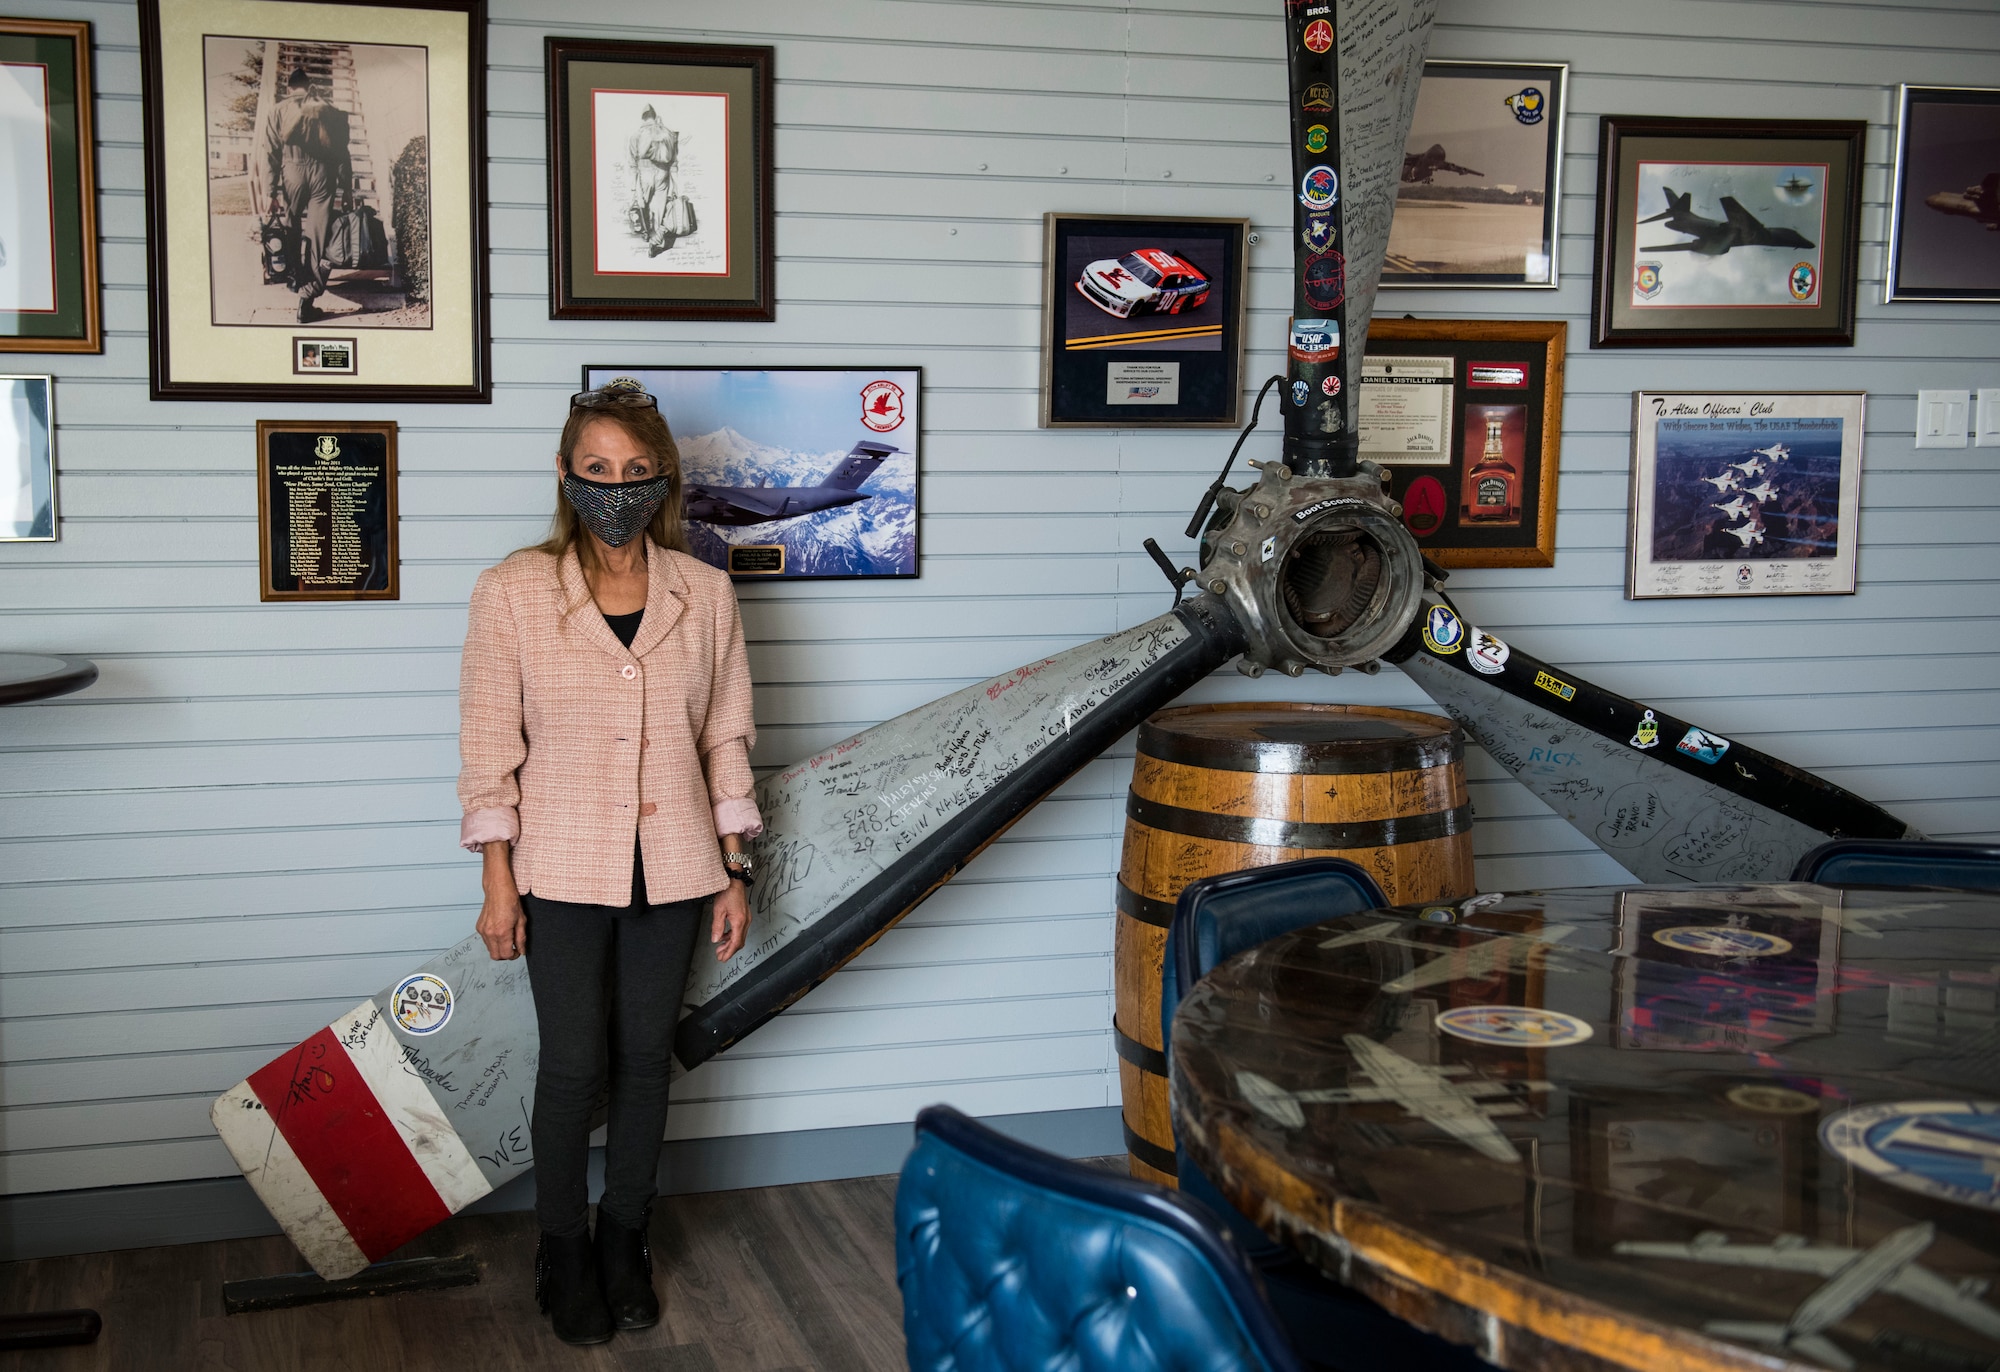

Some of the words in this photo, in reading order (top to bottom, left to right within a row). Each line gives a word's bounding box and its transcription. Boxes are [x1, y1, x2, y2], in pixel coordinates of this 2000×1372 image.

[1306, 6, 1331, 16] BROS.
[1310, 88, 1329, 99] KC135
[1155, 292, 1178, 312] 90
[1302, 334, 1324, 343] USAF
[1652, 398, 1667, 417] To
[1670, 402, 1698, 416] Altus
[1703, 402, 1747, 418] Officers'
[1750, 402, 1775, 416] Club
[1664, 420, 1682, 431] With
[1683, 421, 1708, 431] Sincere
[1710, 421, 1724, 430] Best
[1727, 420, 1752, 432] Wishes,
[1754, 420, 1768, 430] The
[1770, 421, 1790, 430] USAF
[1792, 419, 1838, 430] Thunderbirds
[1296, 503, 1324, 519] Boot
[1538, 672, 1561, 694] 313th
[935, 754, 954, 772] Best
[897, 784, 937, 820] JENKINS
[895, 814, 928, 851] KEVIN
[1608, 808, 1627, 838] JAMES
